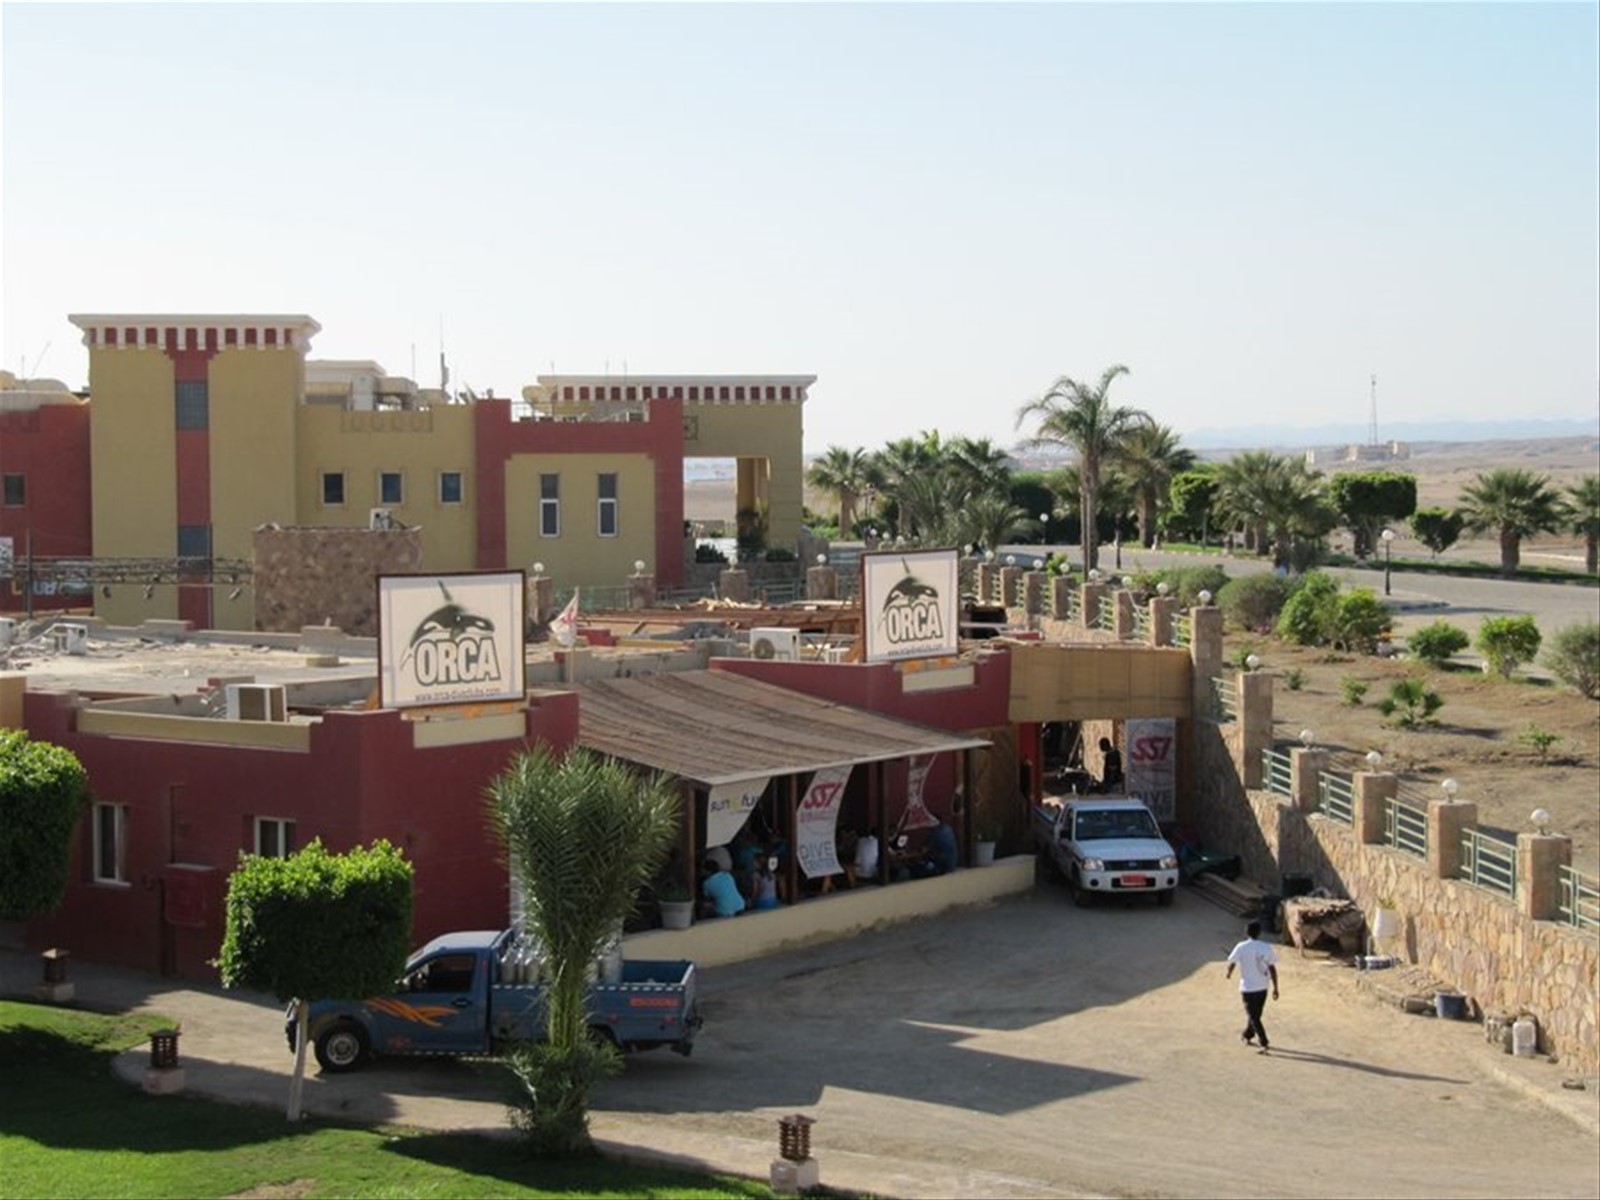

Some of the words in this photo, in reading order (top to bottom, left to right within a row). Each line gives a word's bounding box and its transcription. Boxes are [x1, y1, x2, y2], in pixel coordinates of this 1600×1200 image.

[886, 601, 943, 644] ORCA
[415, 637, 501, 686] ORCA
[1133, 738, 1171, 760] SSI
[804, 783, 842, 808] SSI
[799, 840, 832, 859] DIVE
